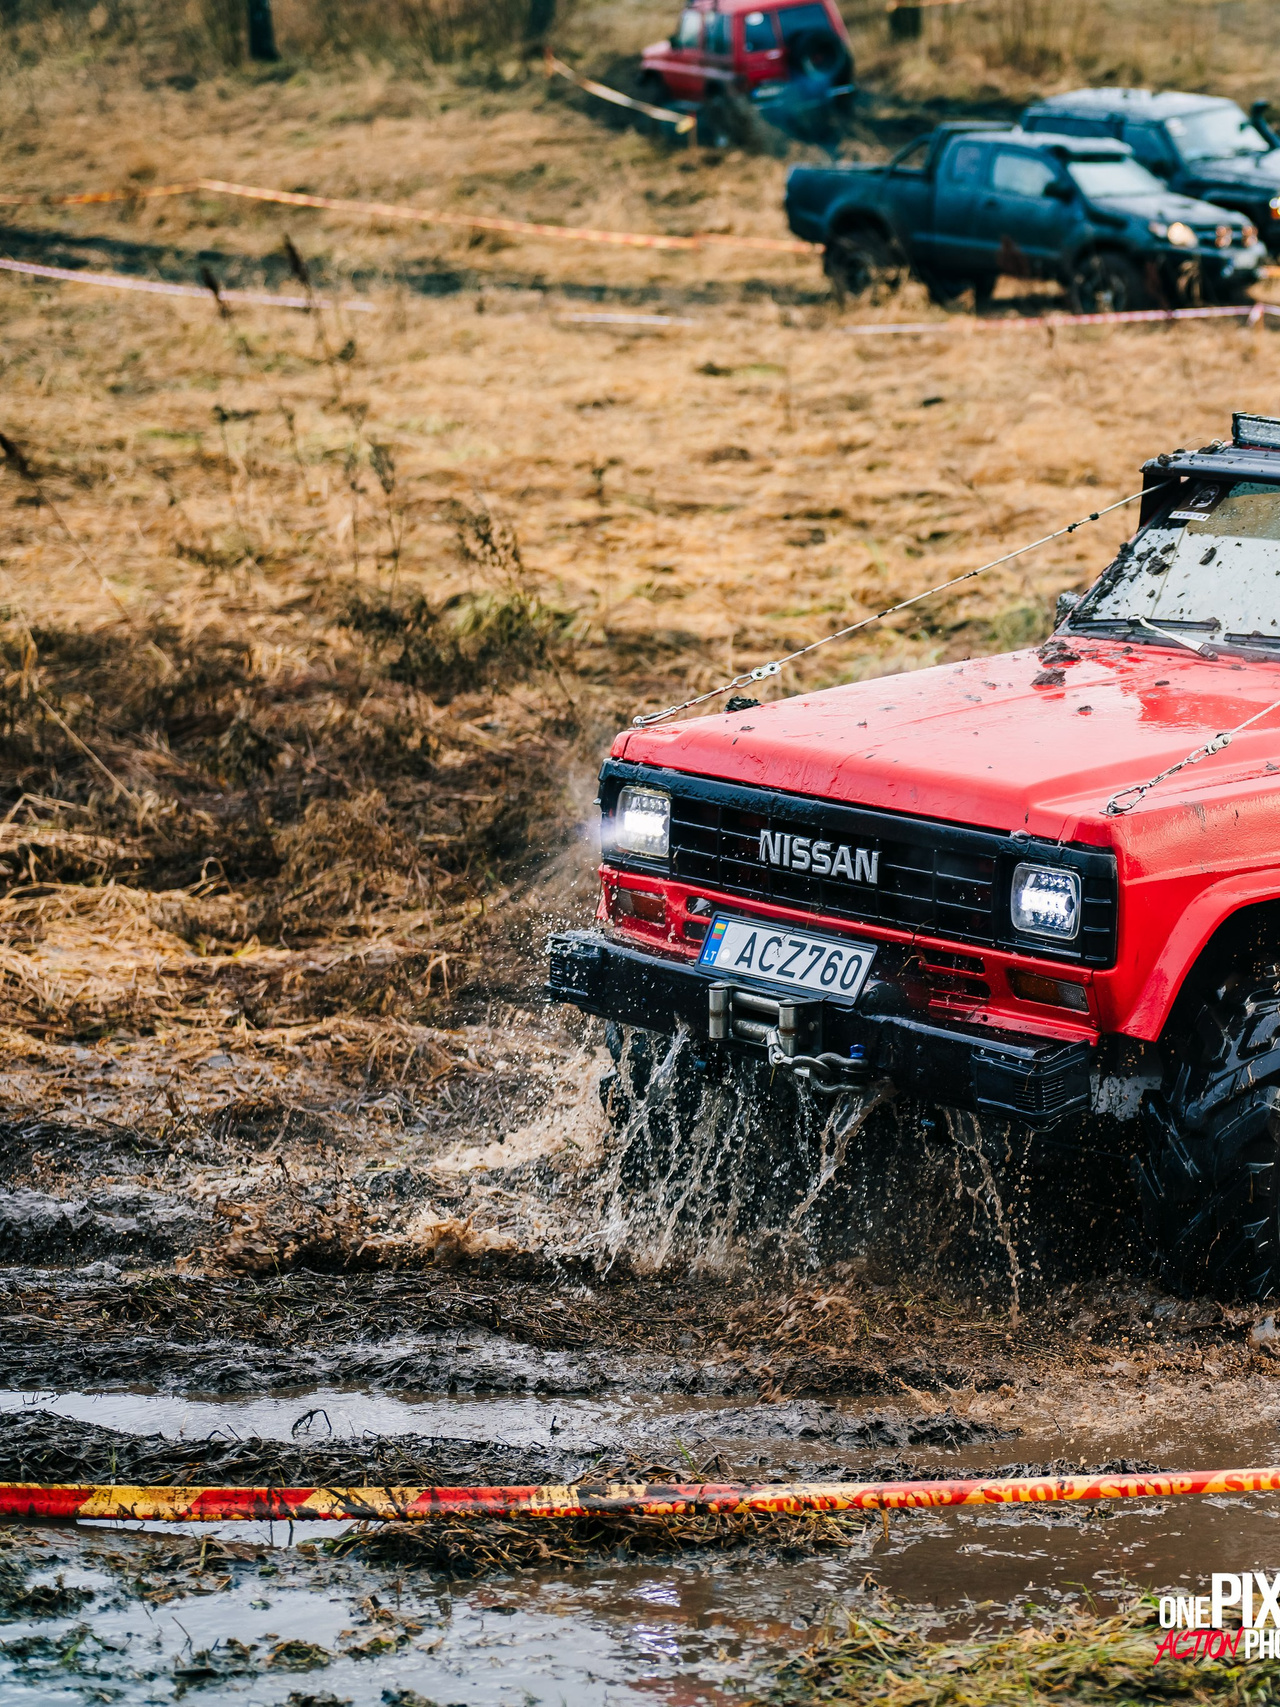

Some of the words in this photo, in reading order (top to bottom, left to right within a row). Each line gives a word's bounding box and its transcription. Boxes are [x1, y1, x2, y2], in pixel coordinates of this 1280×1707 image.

[760, 829, 881, 884] NISSAN
[703, 950, 717, 962] LT
[734, 931, 863, 990] ACZ760
[862, 1489, 952, 1509] STOP
[983, 1482, 1075, 1502] STOP
[1100, 1477, 1193, 1498] STOP
